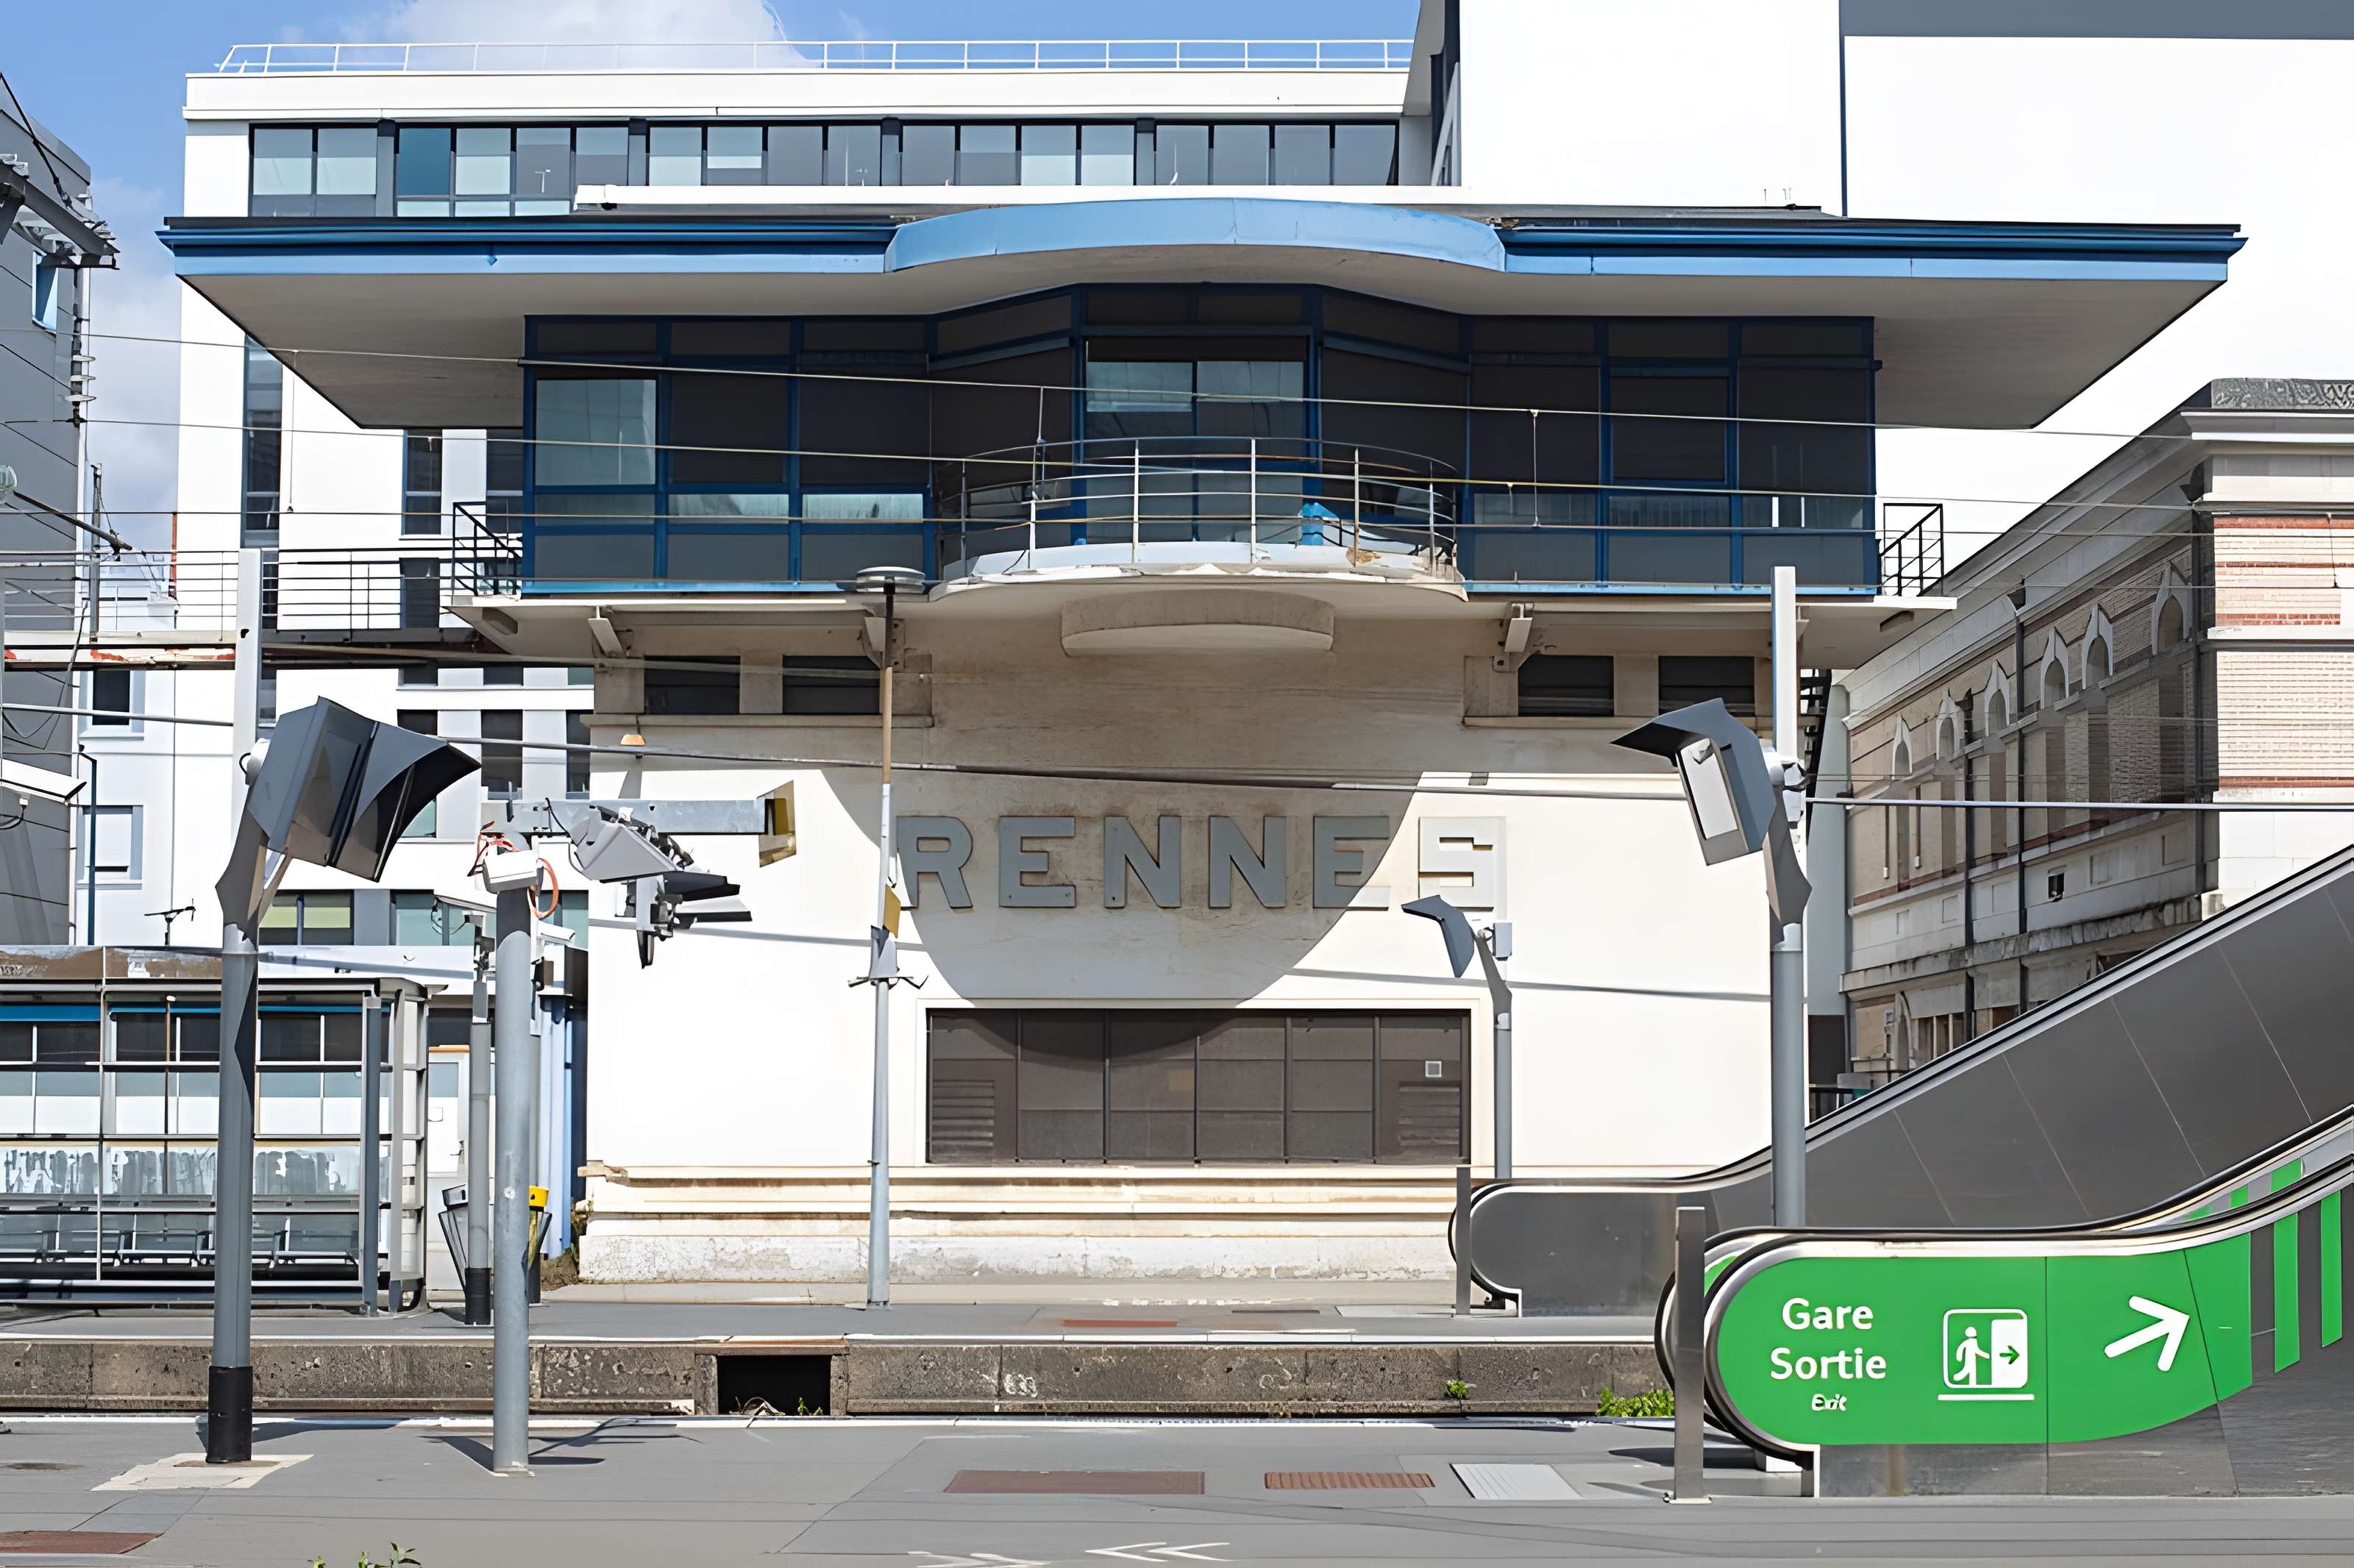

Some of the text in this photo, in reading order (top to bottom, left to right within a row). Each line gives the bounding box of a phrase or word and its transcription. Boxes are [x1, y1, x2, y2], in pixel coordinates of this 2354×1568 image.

[895, 815, 1495, 910] RENNES
[1782, 1297, 1874, 1330] Gare
[1770, 1347, 1887, 1380] Sortie
